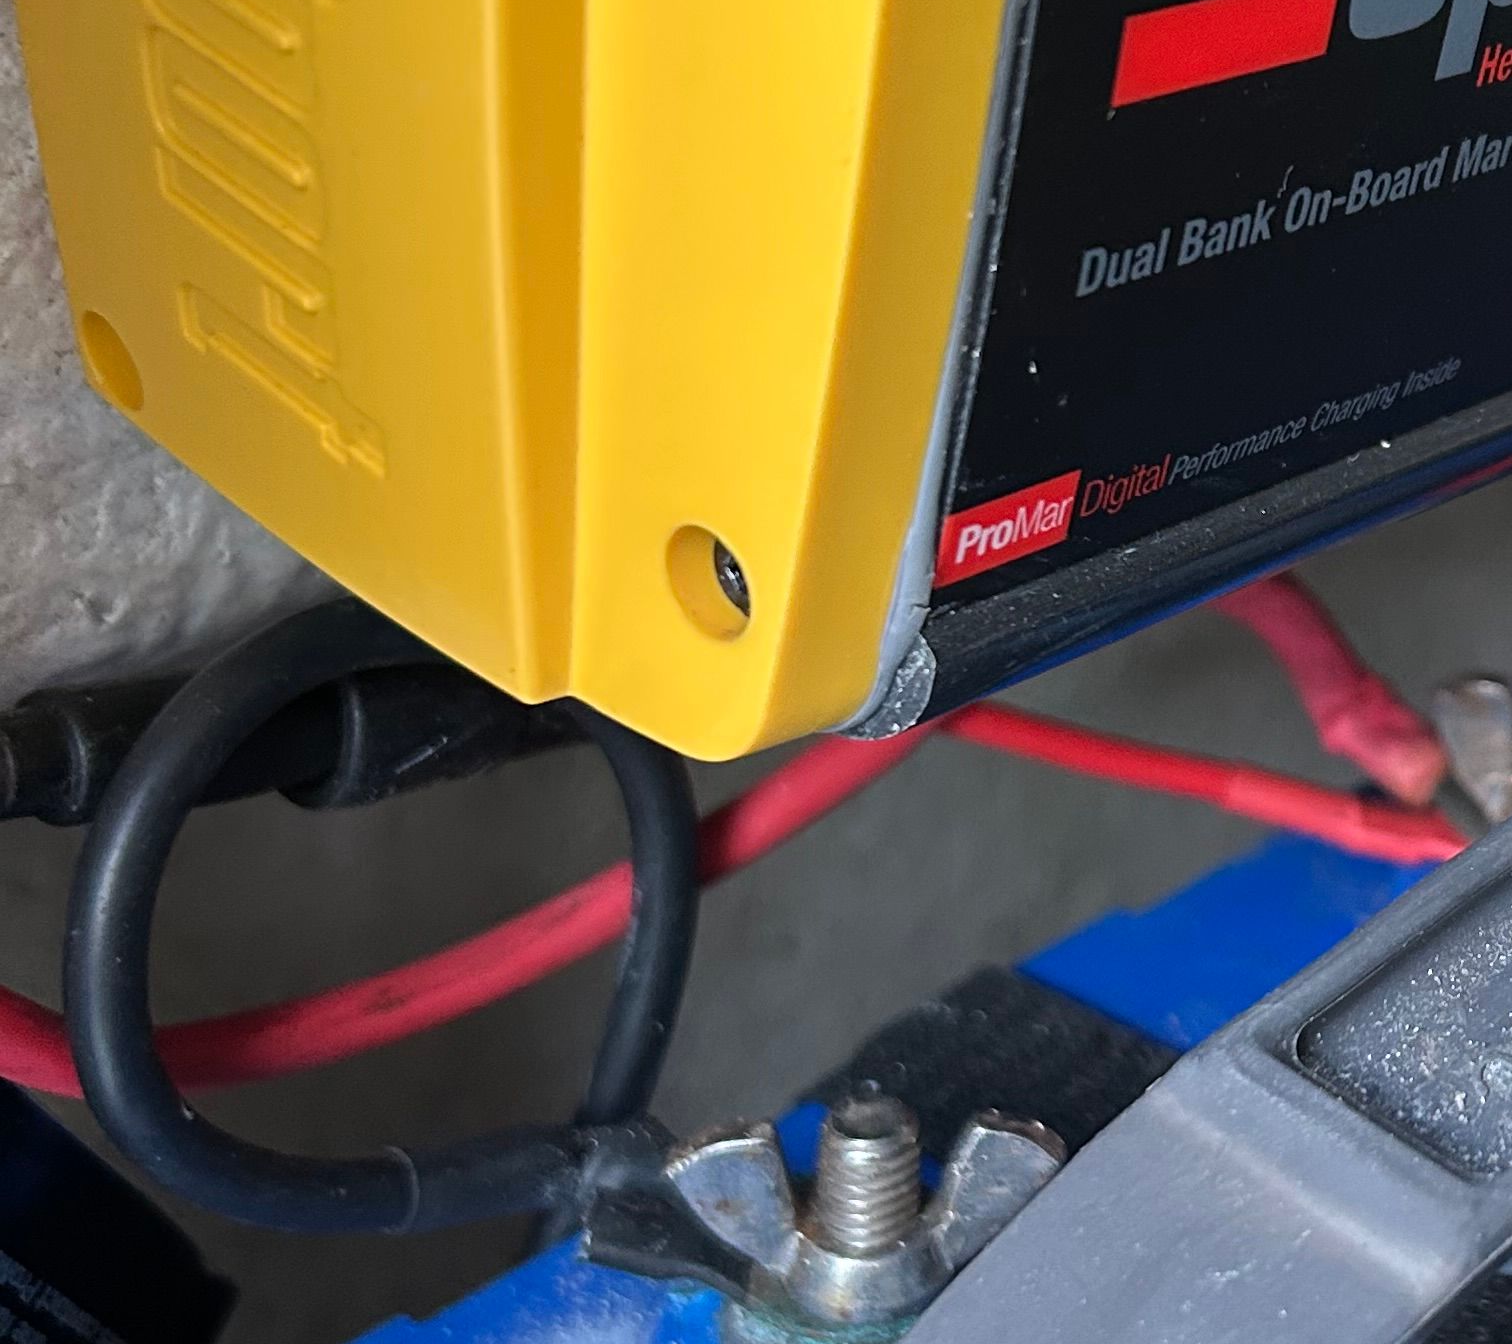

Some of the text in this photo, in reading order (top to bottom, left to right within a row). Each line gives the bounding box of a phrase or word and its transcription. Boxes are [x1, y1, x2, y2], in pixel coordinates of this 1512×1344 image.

[1076, 228, 1170, 297] Dual
[1177, 200, 1277, 266] Bank
[1284, 147, 1450, 234] On-Board
[955, 357, 1462, 564] ProMar Digital Performance Charging Inside
